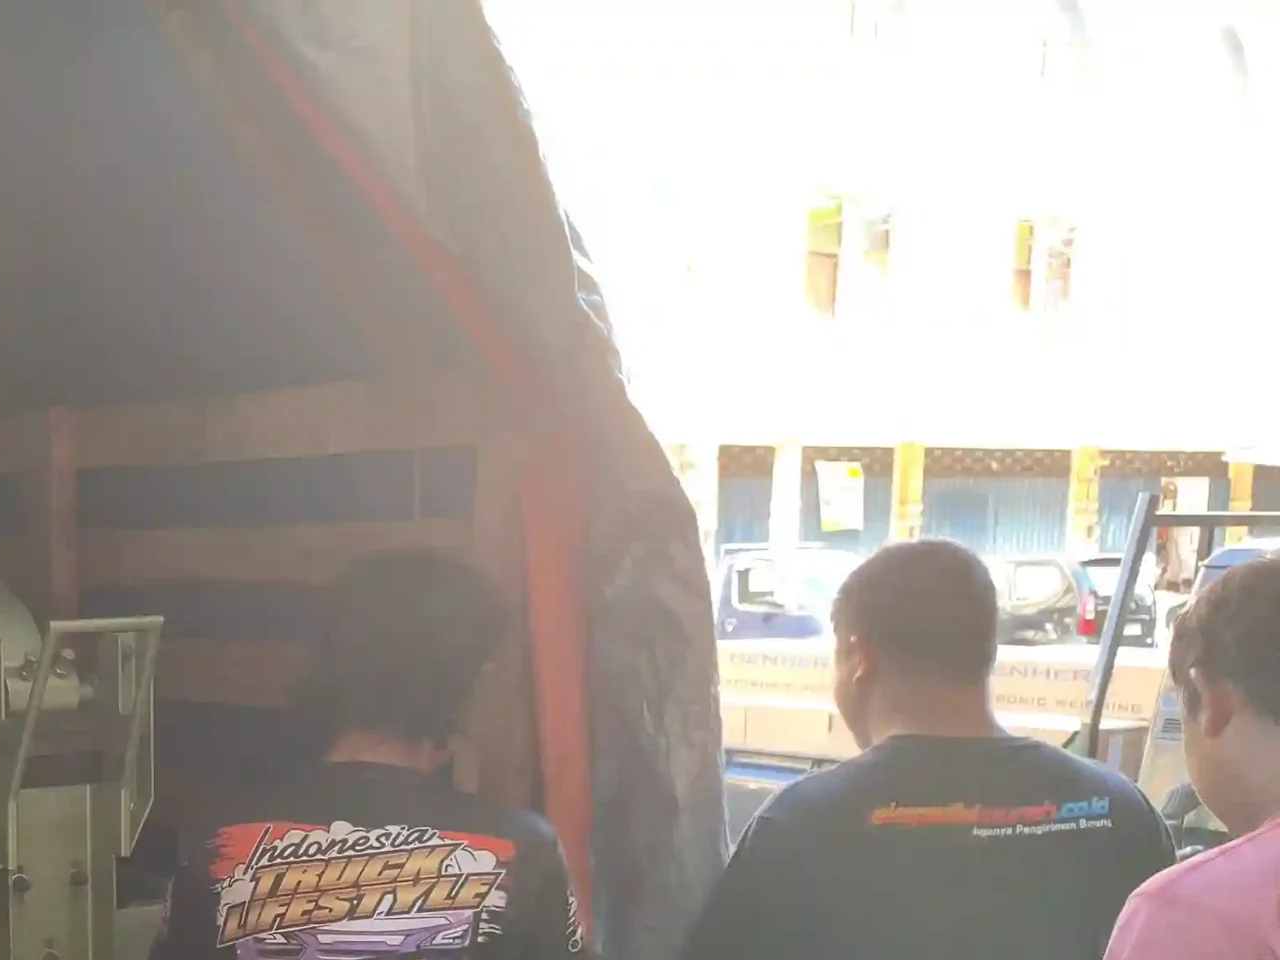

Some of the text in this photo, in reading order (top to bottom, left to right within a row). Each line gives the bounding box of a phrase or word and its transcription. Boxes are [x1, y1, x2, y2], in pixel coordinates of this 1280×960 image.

[244, 825, 438, 876] Indonesia
[251, 842, 465, 901] TRUCK
[218, 872, 504, 946] LIFESTYLE
